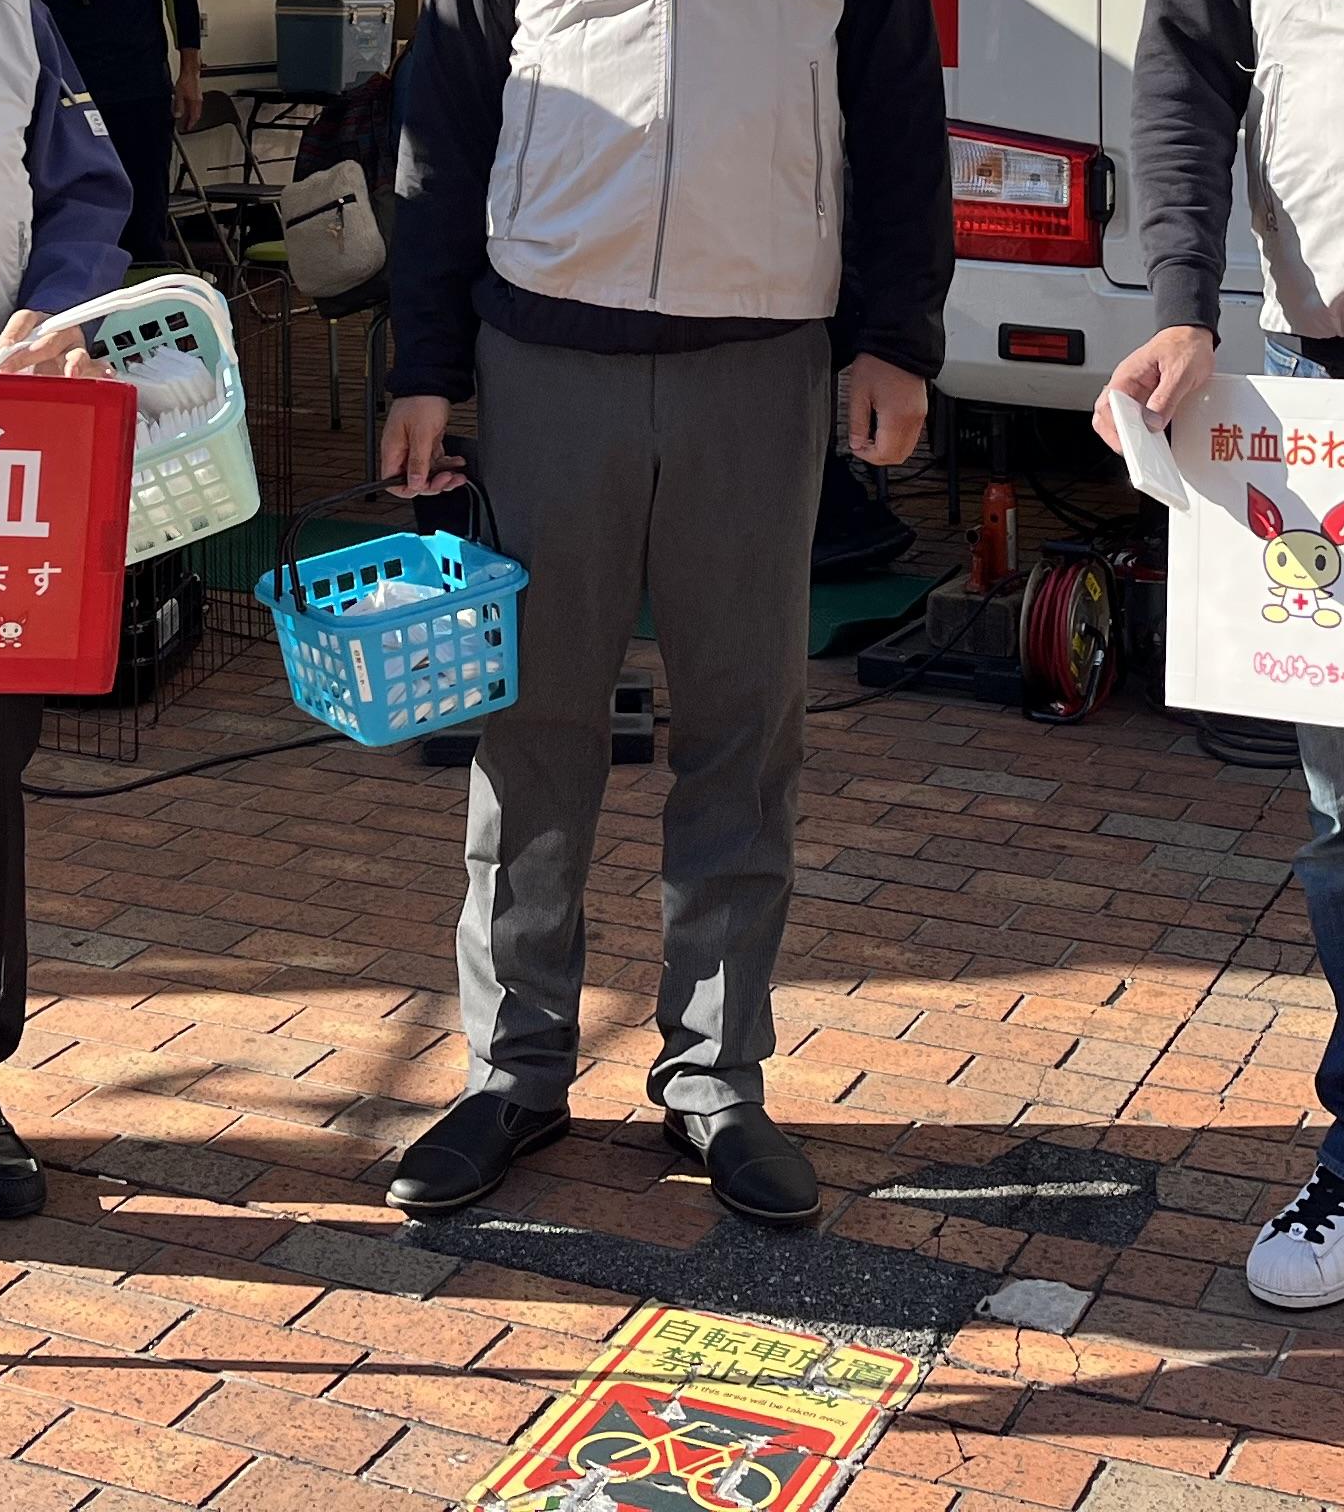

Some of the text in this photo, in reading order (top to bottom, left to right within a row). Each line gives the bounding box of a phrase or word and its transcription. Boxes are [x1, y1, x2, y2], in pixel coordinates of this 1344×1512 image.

[654, 1319, 894, 1386] 自転車放置
[700, 1386, 720, 1396] this
[723, 1391, 747, 1402] area
[750, 1397, 767, 1407] will
[769, 1401, 783, 1410] be
[786, 1406, 817, 1418] taken
[819, 1413, 848, 1427] away
